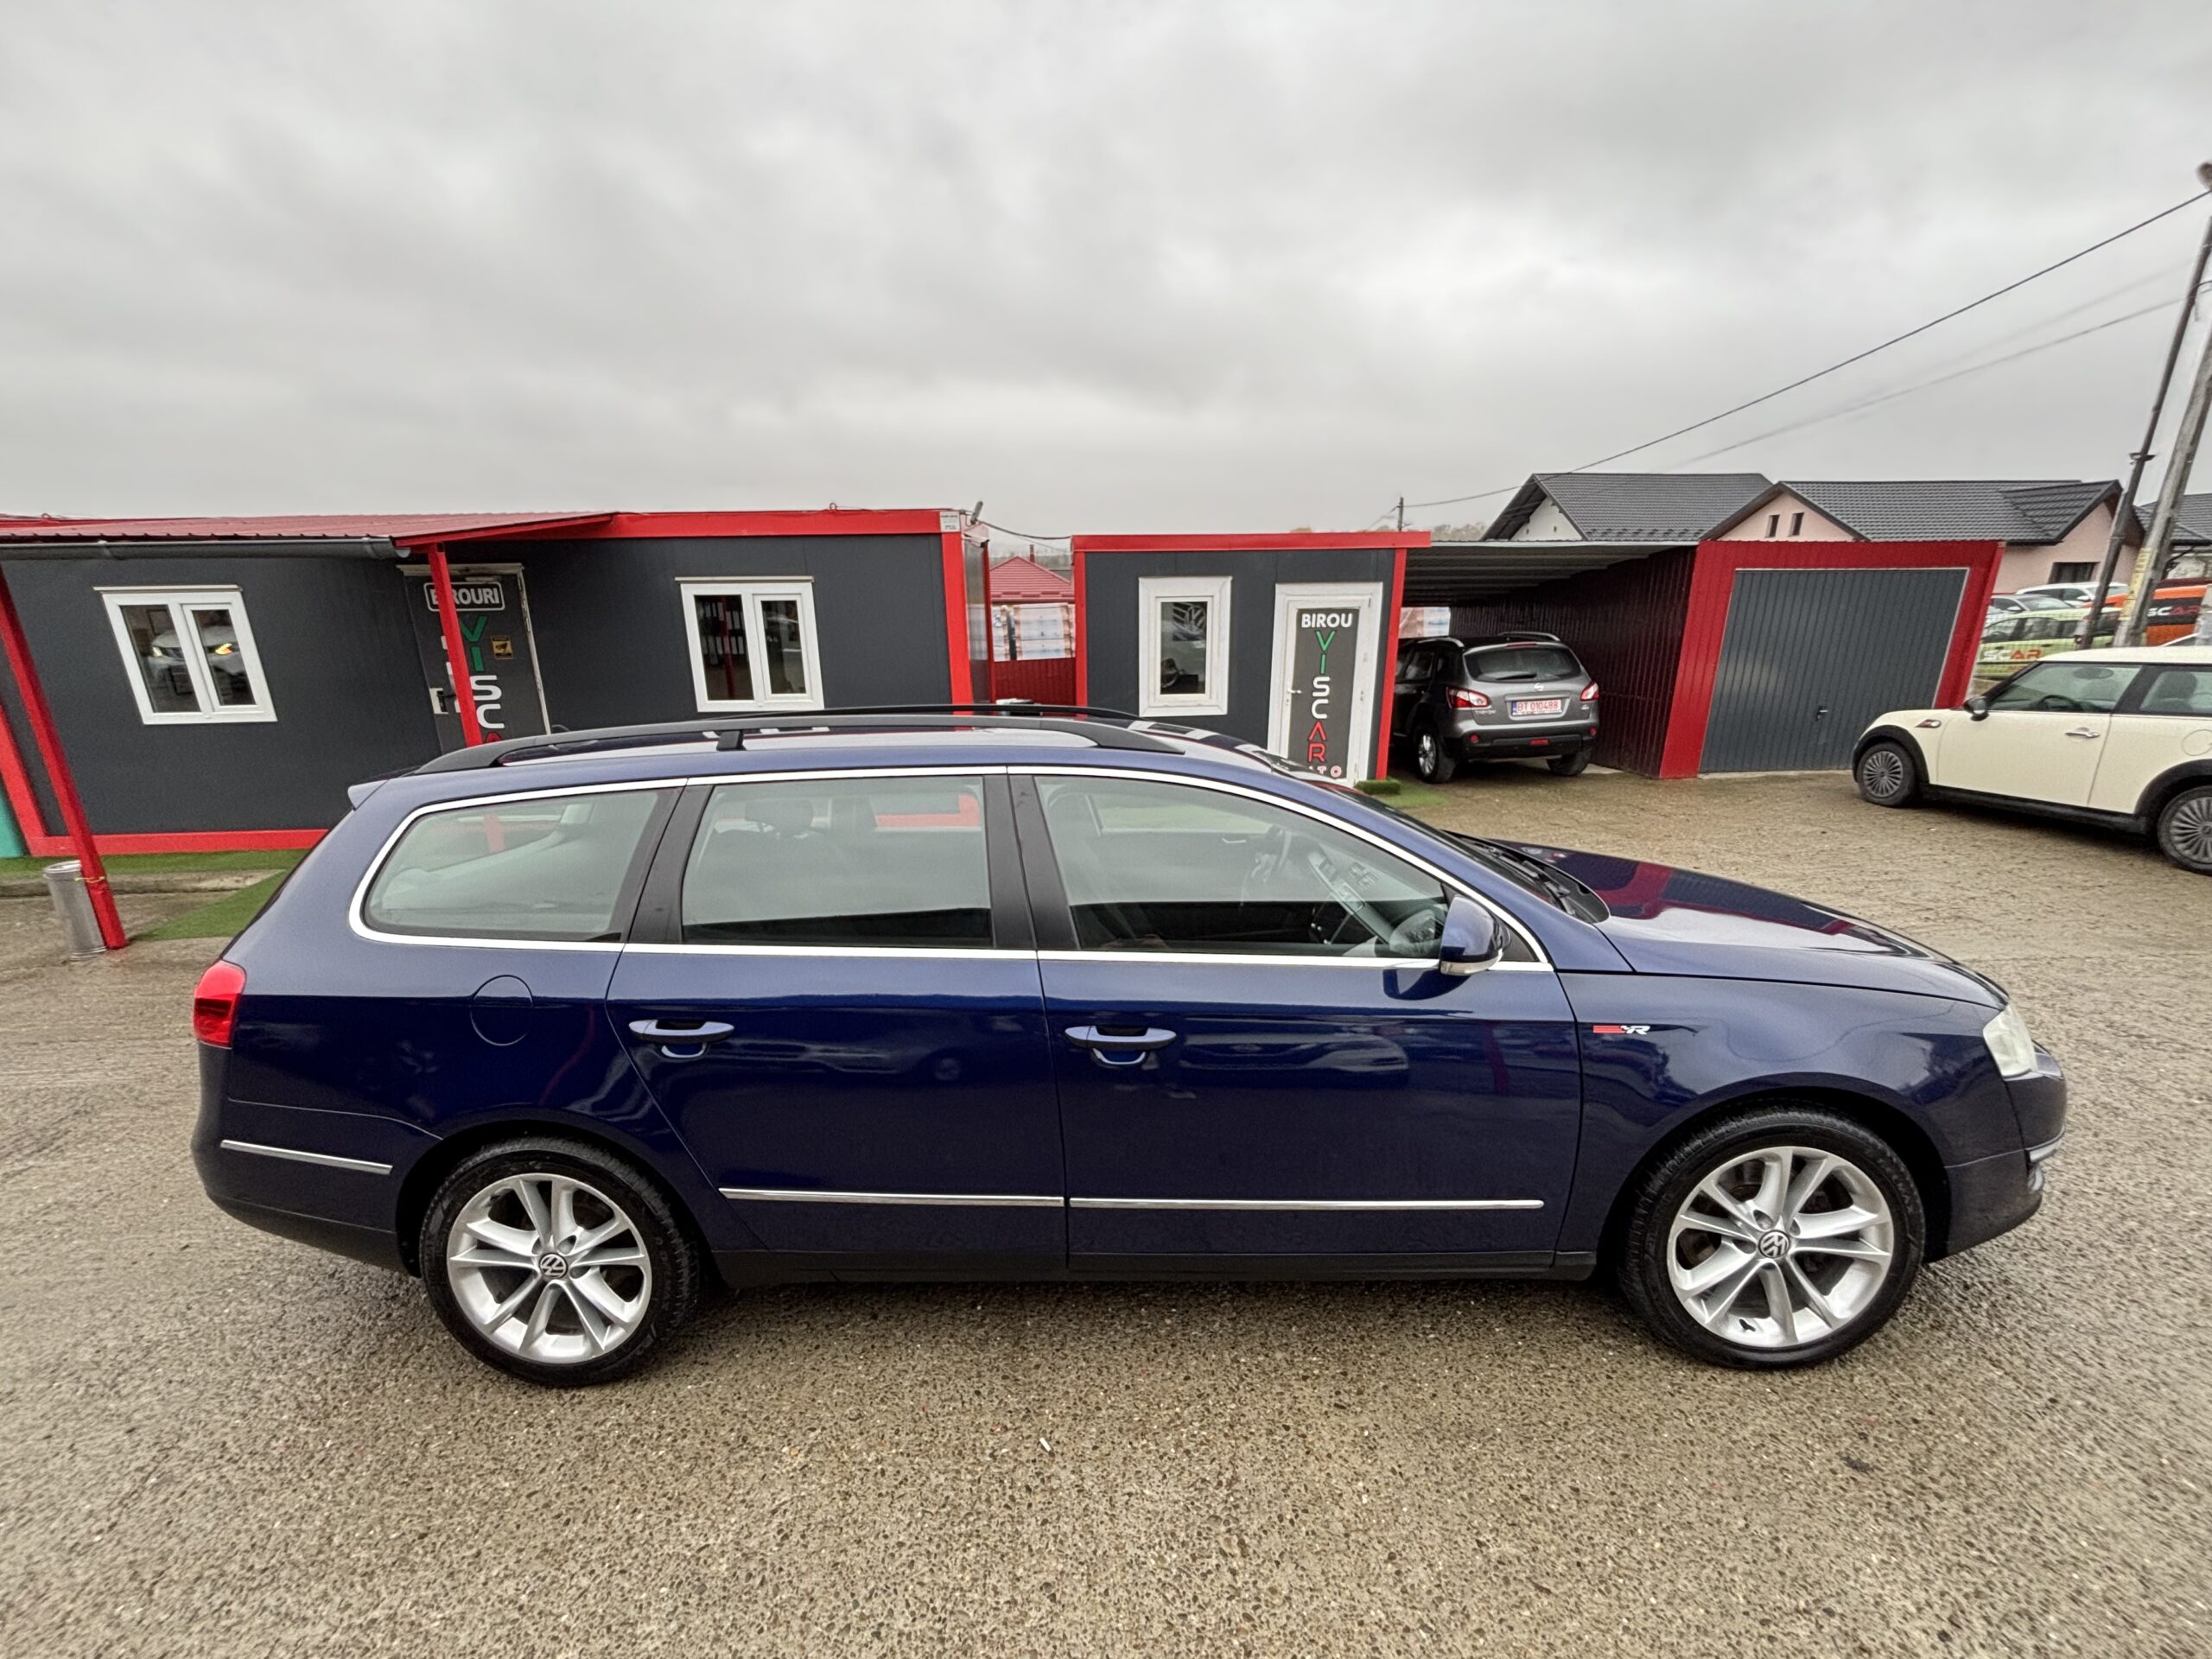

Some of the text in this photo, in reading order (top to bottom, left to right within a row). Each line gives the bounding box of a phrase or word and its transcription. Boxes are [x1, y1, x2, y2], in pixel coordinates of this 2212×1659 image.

[429, 588, 499, 605] BROURI
[1301, 613, 1353, 628] BIROU
[1307, 630, 1337, 762] VISCAR
[1517, 702, 1528, 711] BT
